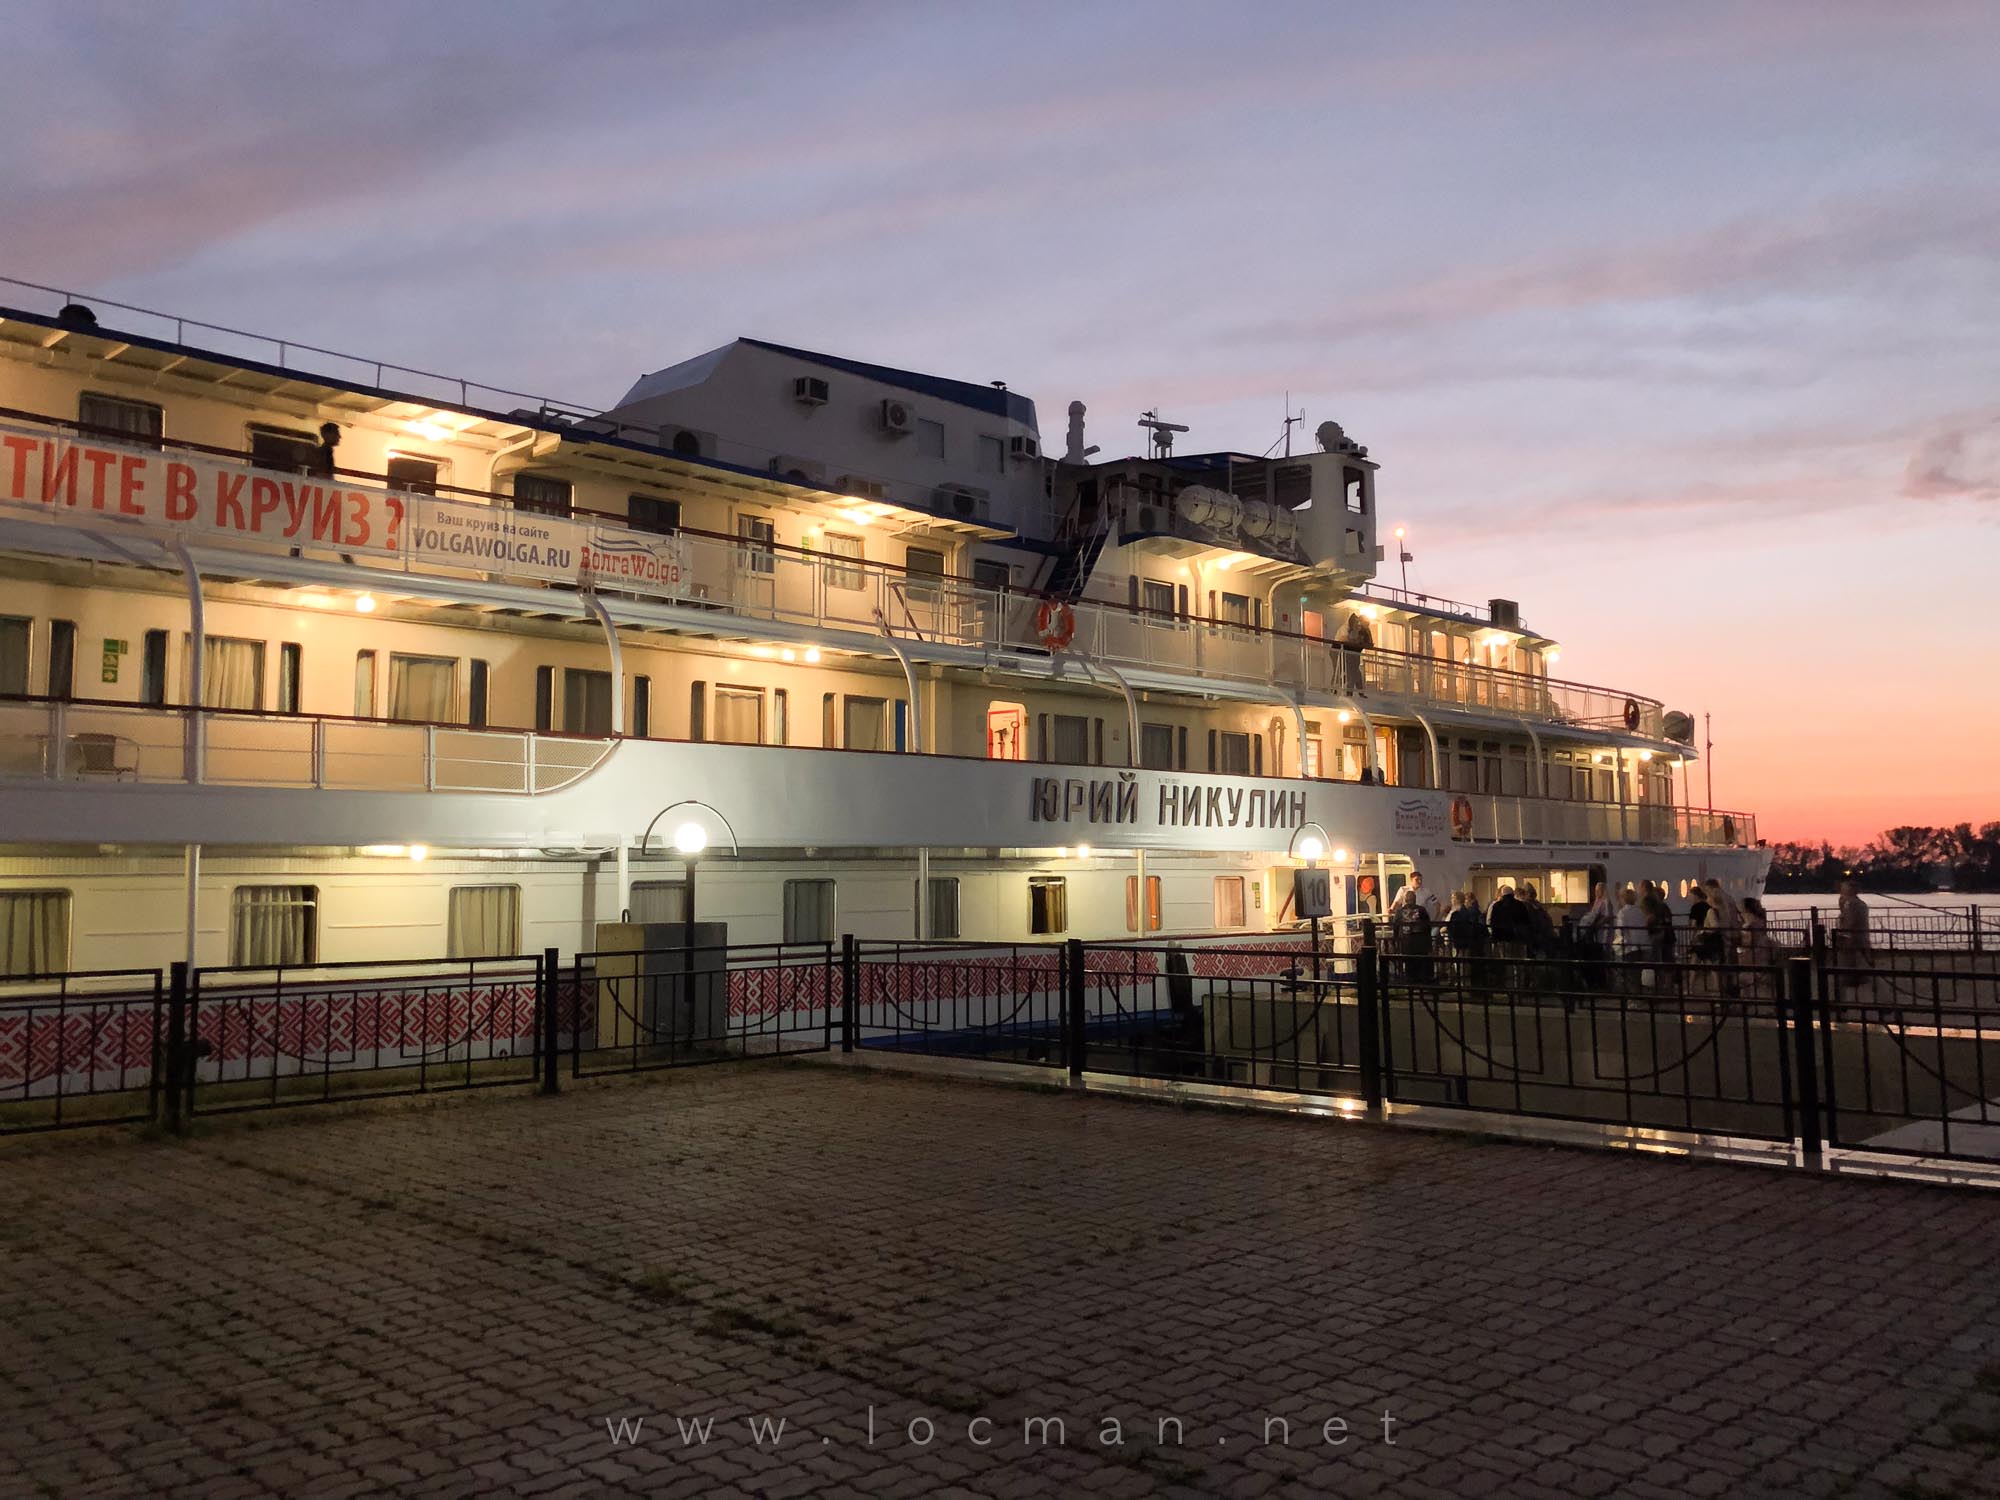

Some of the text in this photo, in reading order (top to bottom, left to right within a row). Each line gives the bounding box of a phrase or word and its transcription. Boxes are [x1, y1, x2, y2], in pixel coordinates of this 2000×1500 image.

[3, 435, 405, 551] ТИТЕ В КРУИЗ?
[437, 511, 550, 541] Ваш круиз на сайте
[412, 527, 571, 568] VOLGAWOLGA.RU
[1031, 771, 1307, 830] ЮРИЙ НИКУЛИН
[1308, 878, 1326, 907] 10
